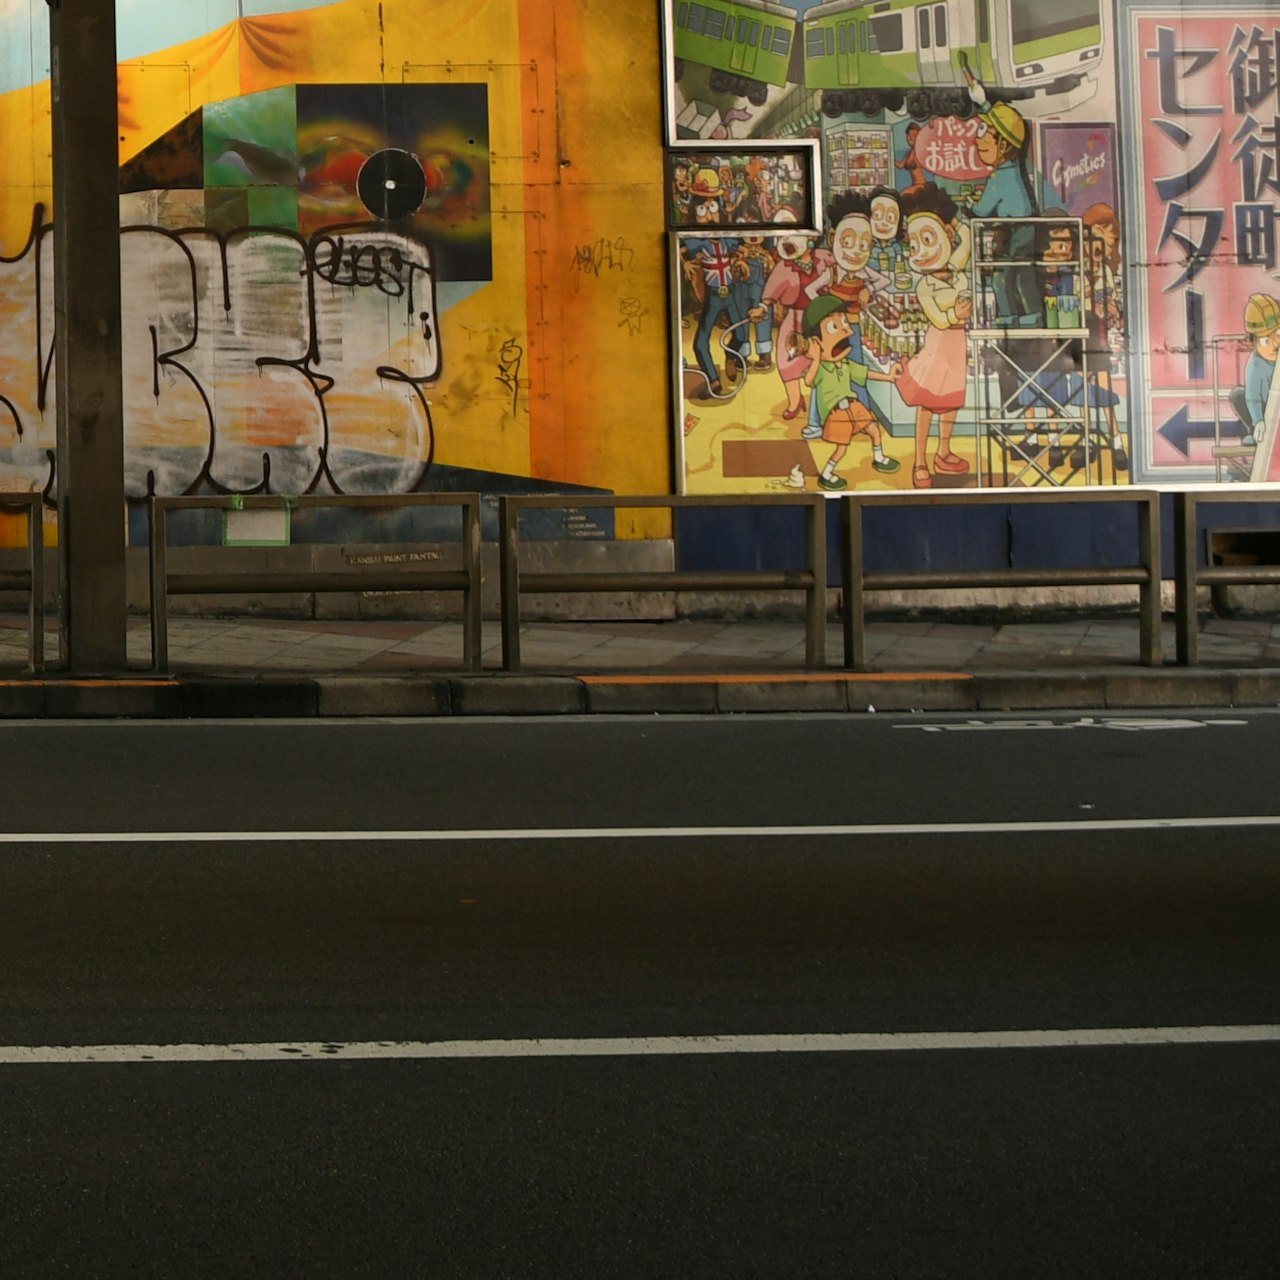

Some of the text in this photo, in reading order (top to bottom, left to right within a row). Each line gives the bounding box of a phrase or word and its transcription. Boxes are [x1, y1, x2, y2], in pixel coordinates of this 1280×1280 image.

[925, 139, 992, 172] お試し
[1144, 23, 1226, 381] センター
